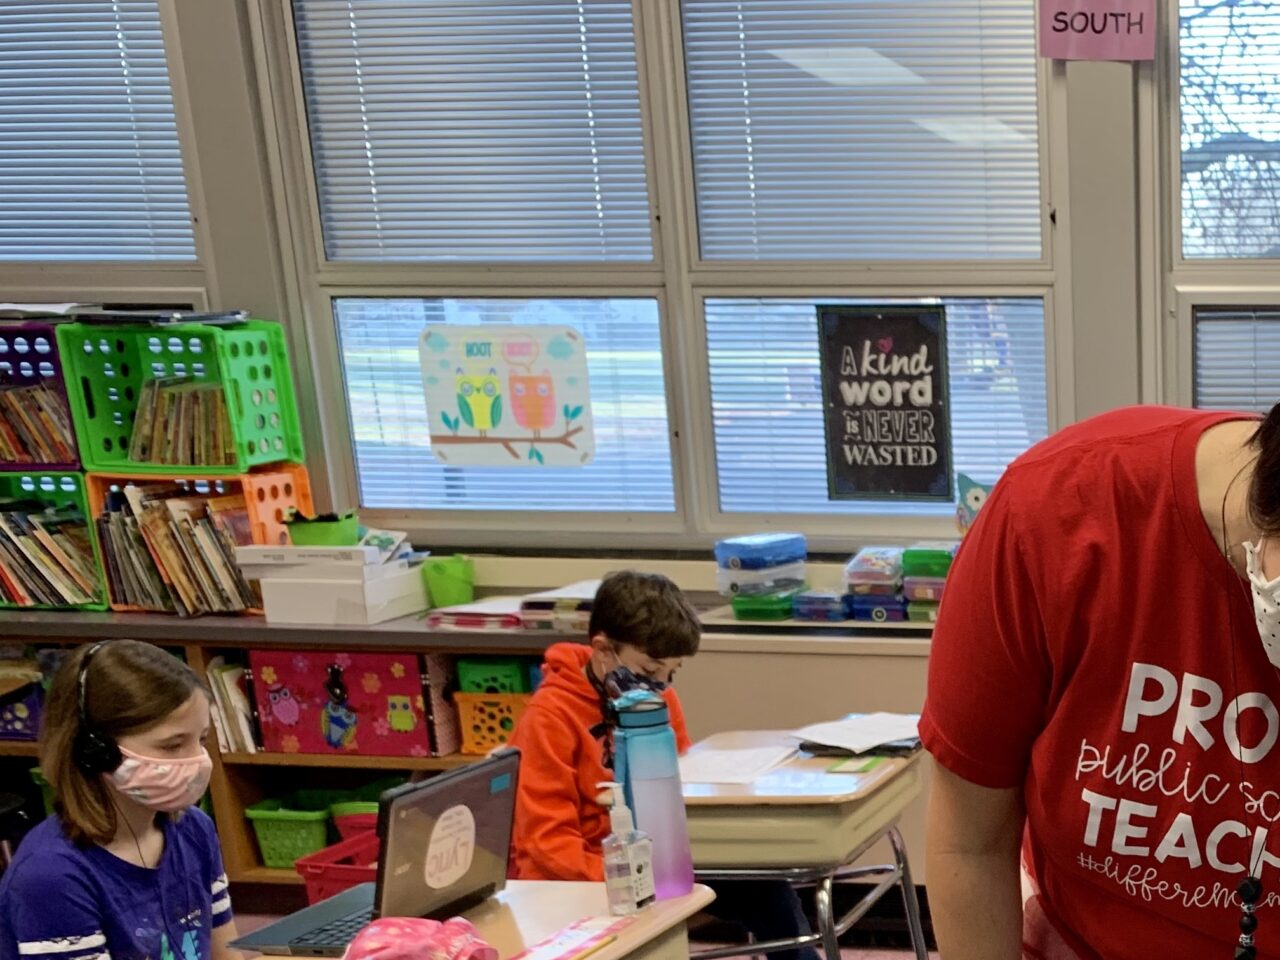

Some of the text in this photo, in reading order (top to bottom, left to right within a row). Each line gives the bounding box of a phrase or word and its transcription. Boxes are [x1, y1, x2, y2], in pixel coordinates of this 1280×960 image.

[1052, 11, 1144, 34] SOUTH
[841, 338, 934, 376] A kind
[839, 375, 933, 407] word
[846, 409, 936, 443] is NEVER
[842, 445, 938, 466] WASTED
[1075, 738, 1231, 805] public
